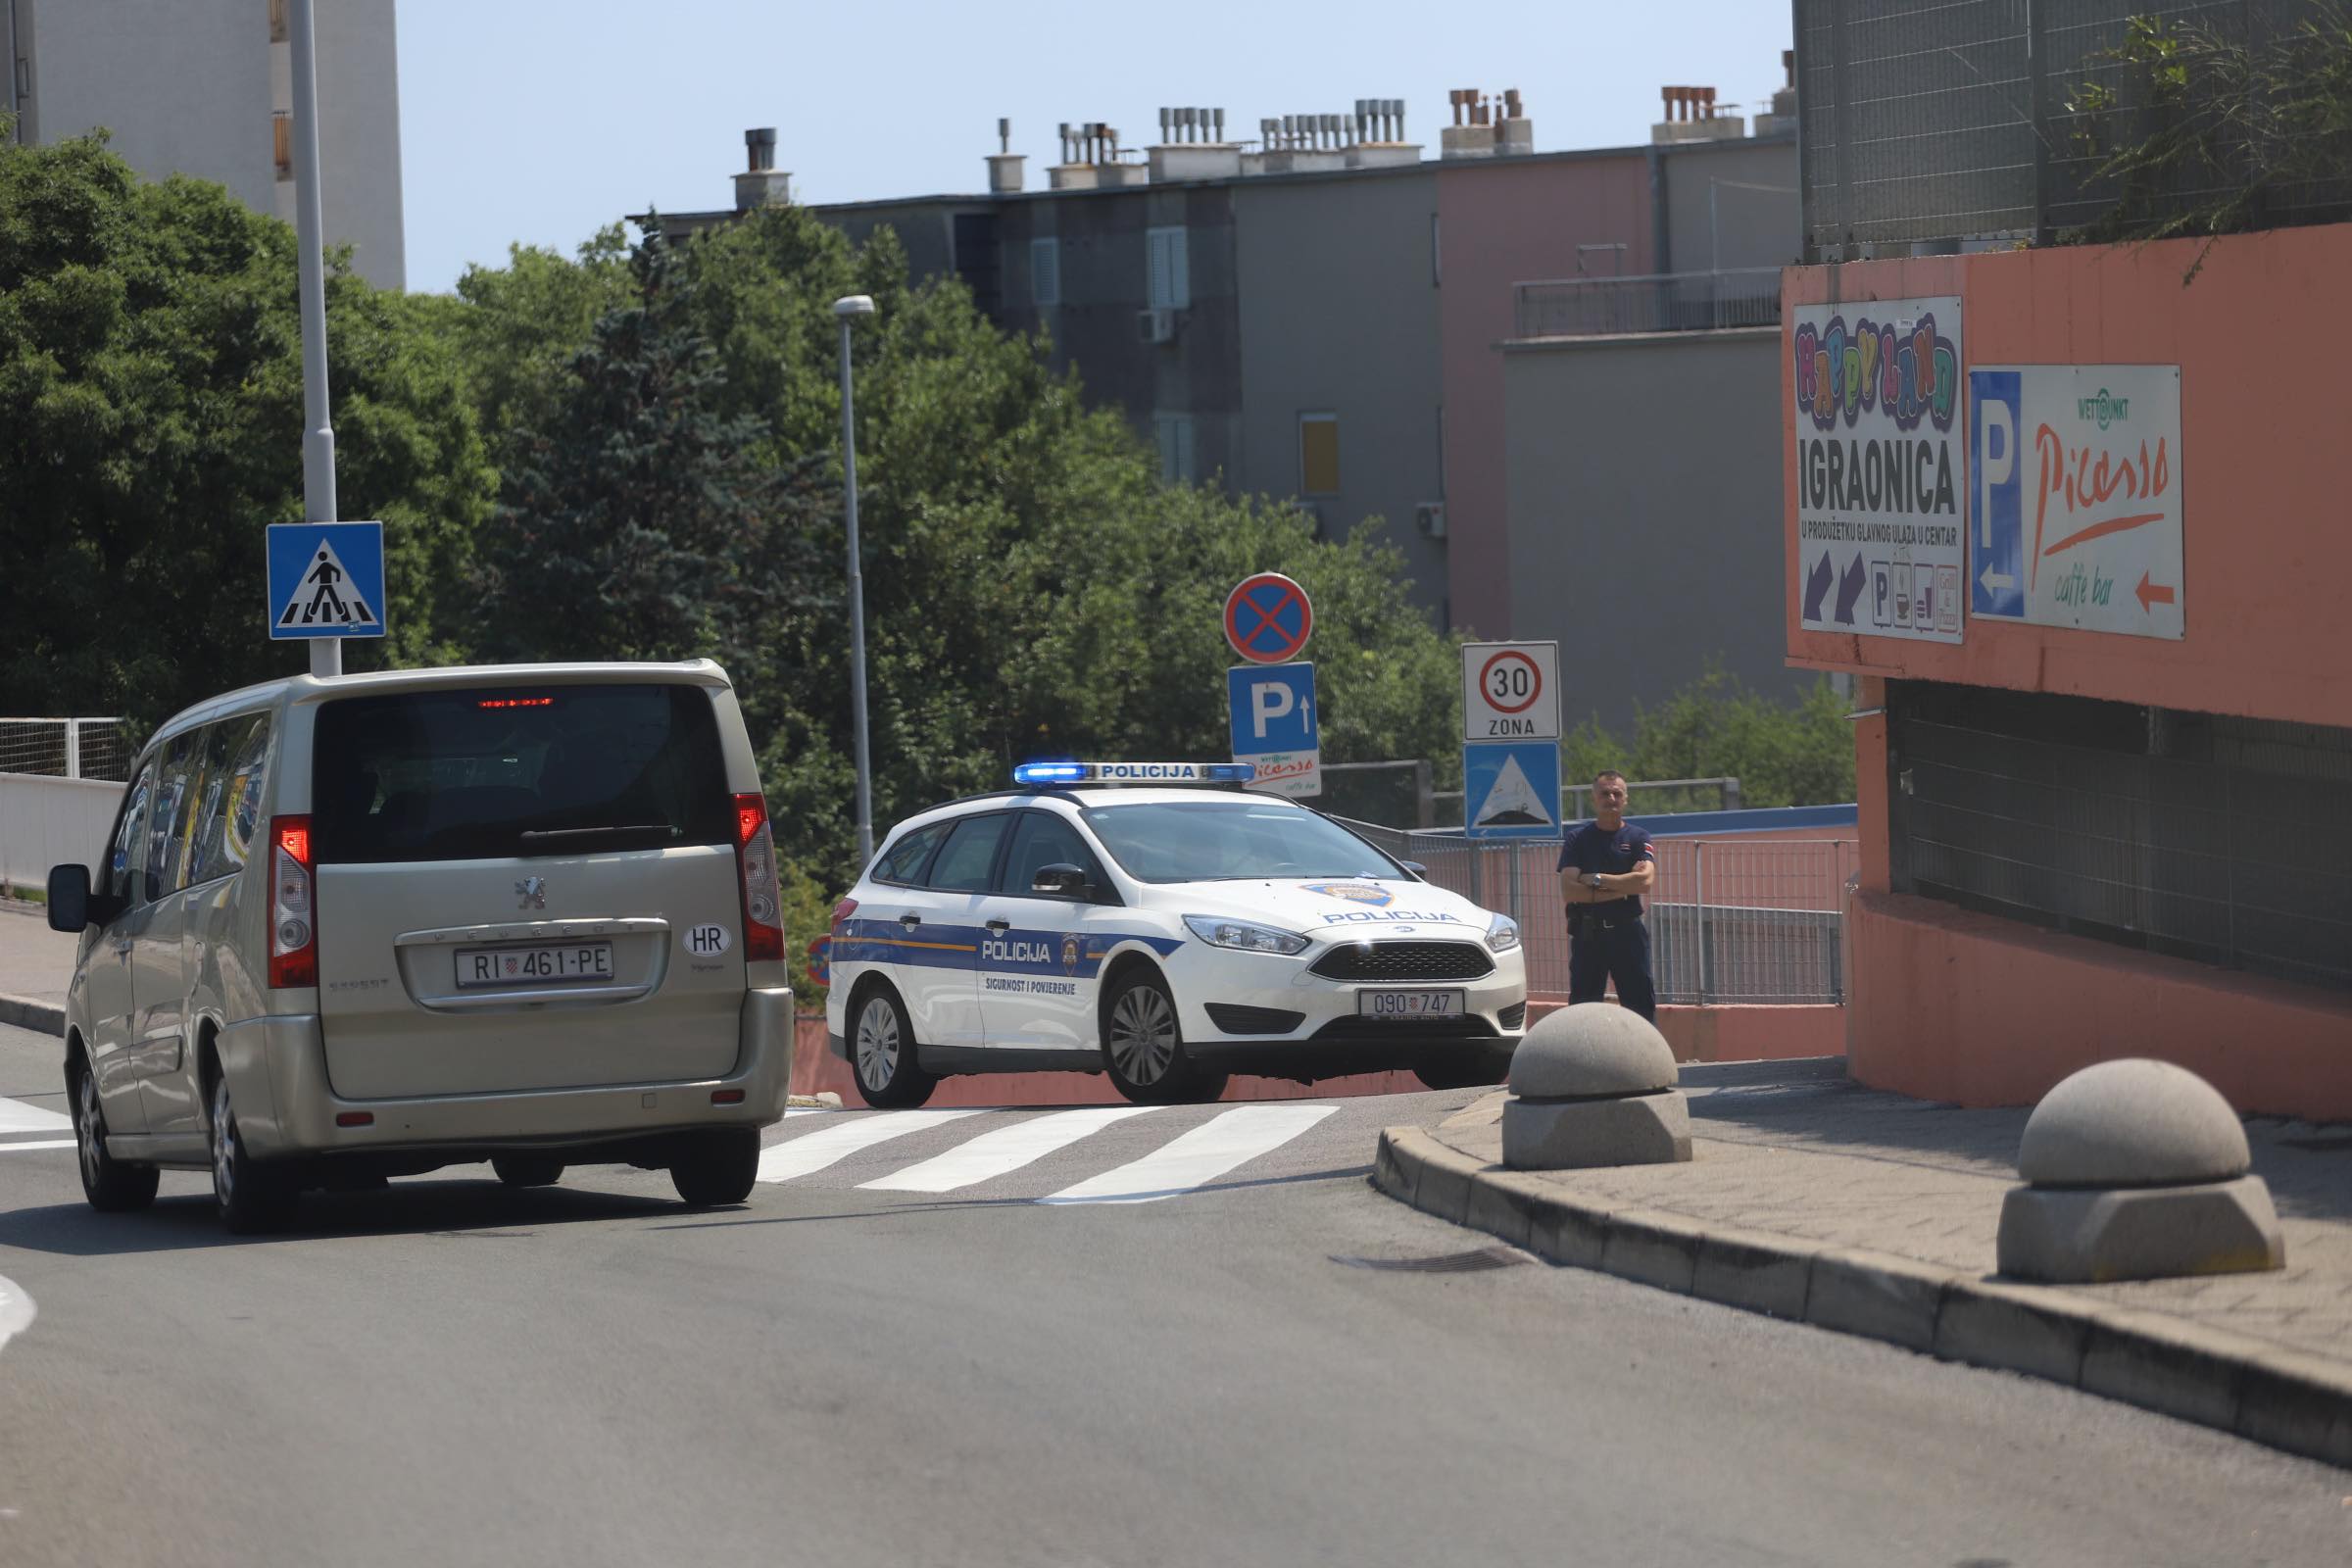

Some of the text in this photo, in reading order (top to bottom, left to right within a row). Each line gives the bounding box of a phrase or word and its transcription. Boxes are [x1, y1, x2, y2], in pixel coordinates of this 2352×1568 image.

[1796, 322, 1955, 420] HAPPY LAND
[1800, 439, 1956, 514] IGRAONICA
[1981, 399, 2015, 549] P
[2032, 422, 2169, 593] Picasso
[1801, 515, 1958, 547] U PRODUŽETKU GLAVNOG ULAZA U CENTAR
[1876, 571, 1887, 617] P
[2092, 564, 2115, 606] bar
[1494, 667, 1528, 697] 30
[1250, 682, 1294, 738] P
[1489, 718, 1535, 736] ZONA
[1102, 764, 1196, 778] POLICIJA
[1323, 910, 1462, 924] POLICIJA
[692, 927, 722, 951] HR
[982, 940, 1051, 963] POLICIJA
[474, 948, 609, 980] RI 461-PE
[986, 977, 1025, 993] SIGURNOST
[1031, 981, 1076, 996] POVJERENJE
[1374, 994, 1450, 1013] 090 747
